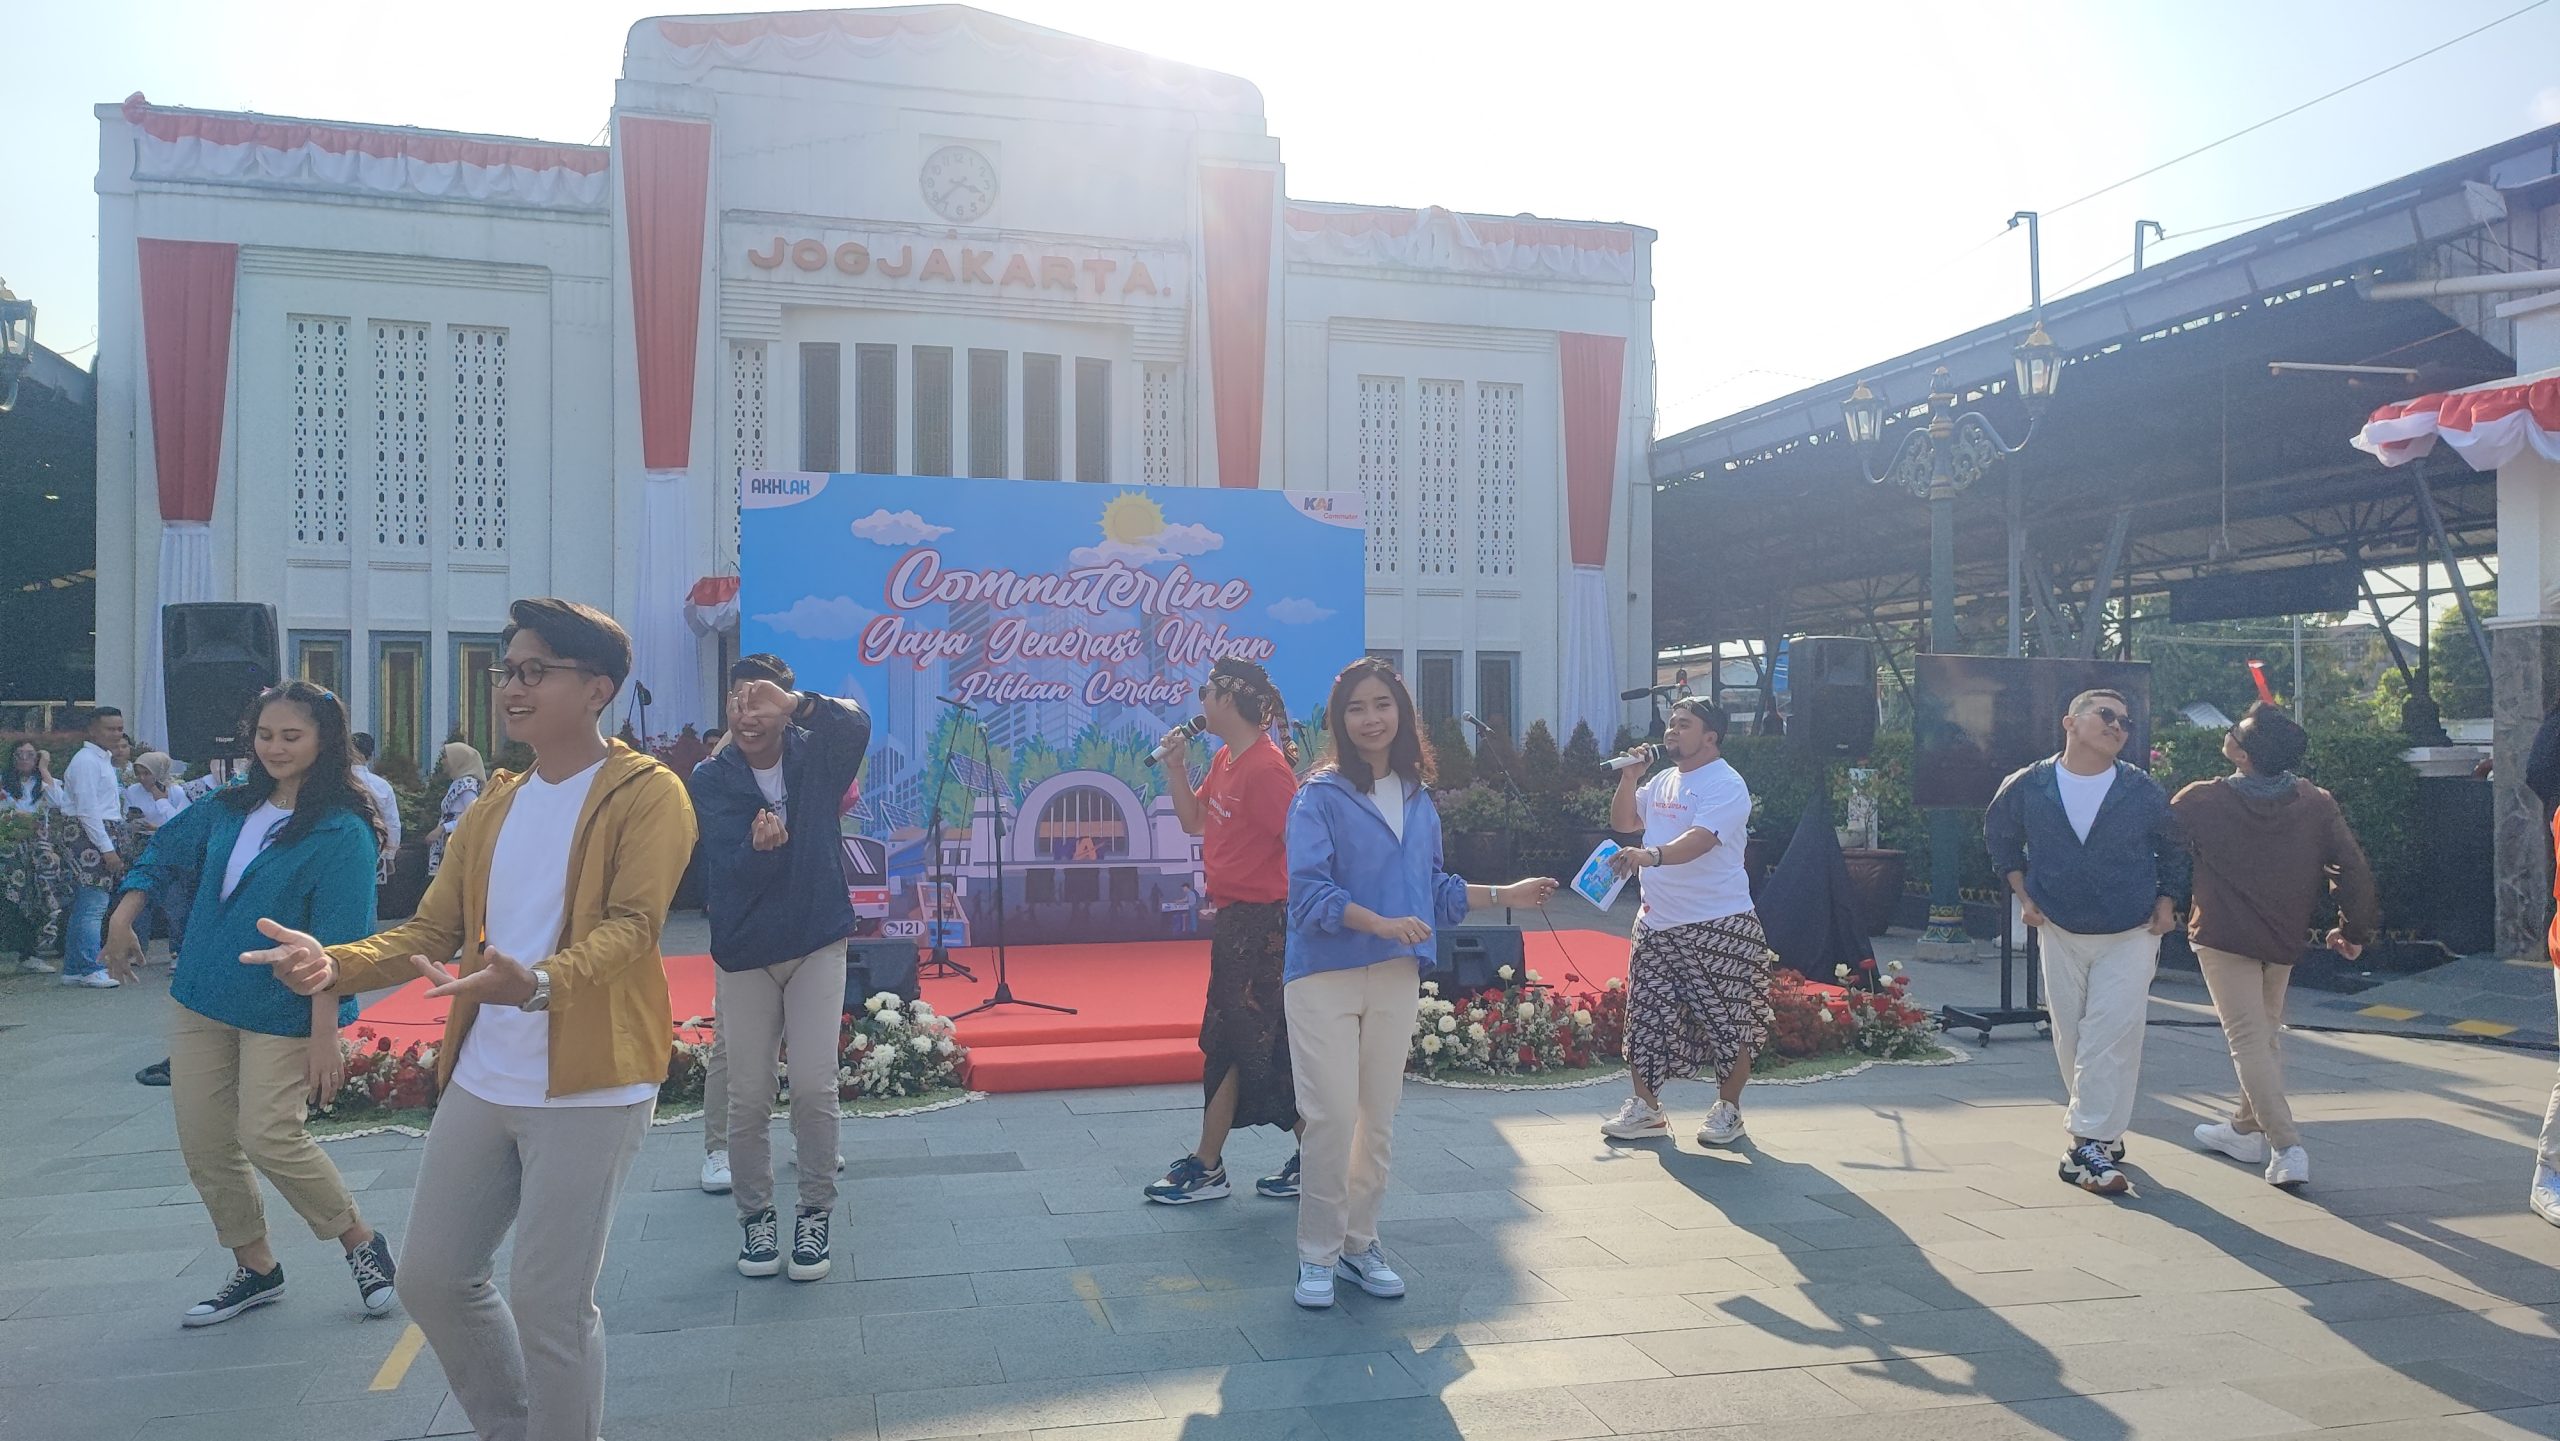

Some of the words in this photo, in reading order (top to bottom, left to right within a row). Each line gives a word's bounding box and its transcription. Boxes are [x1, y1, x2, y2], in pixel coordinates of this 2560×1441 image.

[751, 478, 811, 496] AKHLAK
[1303, 496, 1334, 512] KAI
[1323, 512, 1359, 521] Commuter
[887, 548, 1251, 616] Commuterline
[863, 616, 974, 667] Gaya
[987, 616, 1144, 664] Generasi
[1157, 615, 1275, 664] Urban
[960, 670, 1072, 705] Pilihan
[1084, 669, 1192, 706] Cerdas
[900, 921, 919, 936] 121
